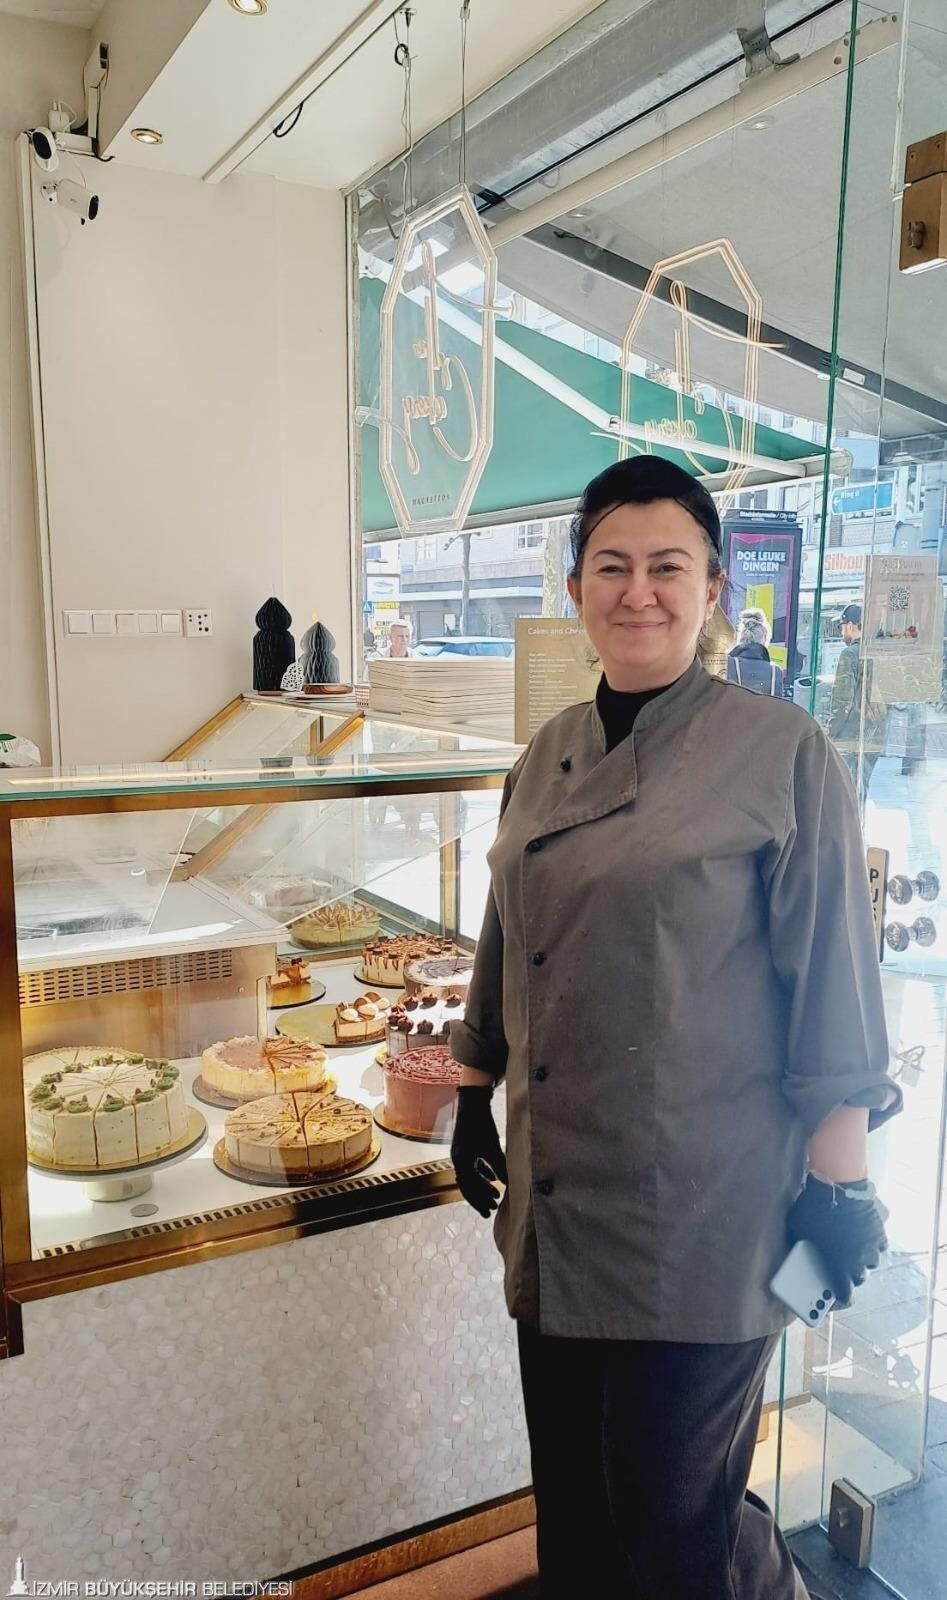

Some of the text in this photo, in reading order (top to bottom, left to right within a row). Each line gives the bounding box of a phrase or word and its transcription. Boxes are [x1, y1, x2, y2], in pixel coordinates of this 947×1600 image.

[737, 551, 786, 562] DOE LEUKE
[825, 552, 864, 570] Silhou
[743, 561, 779, 572] DINGEN
